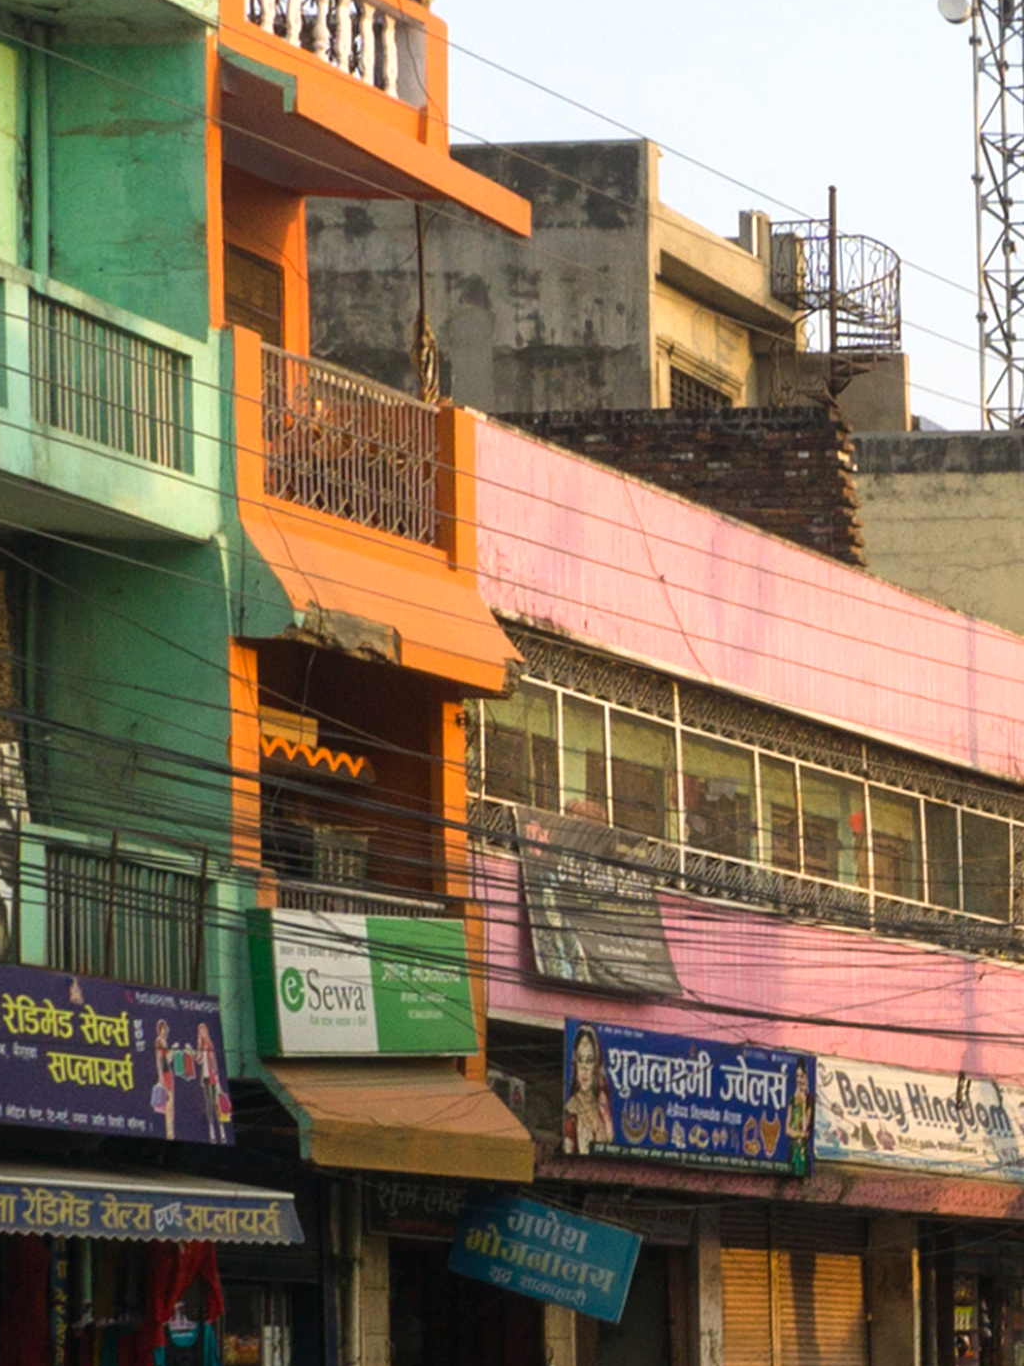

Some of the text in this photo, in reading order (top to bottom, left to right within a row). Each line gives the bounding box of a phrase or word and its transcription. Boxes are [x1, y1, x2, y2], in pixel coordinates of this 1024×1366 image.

[280, 967, 367, 1013] eSewa
[2, 993, 74, 1039] रेडिमेड
[46, 1051, 134, 1091] सप्लायर्स
[607, 1046, 788, 1110] शुभलक्ष्मी ज्वेलर्स
[834, 1070, 1012, 1136] Baby Kingdom
[100, 1193, 152, 1232] सेल्स
[184, 1202, 281, 1236] सप्लायर्स
[507, 1210, 589, 1254] गणेश
